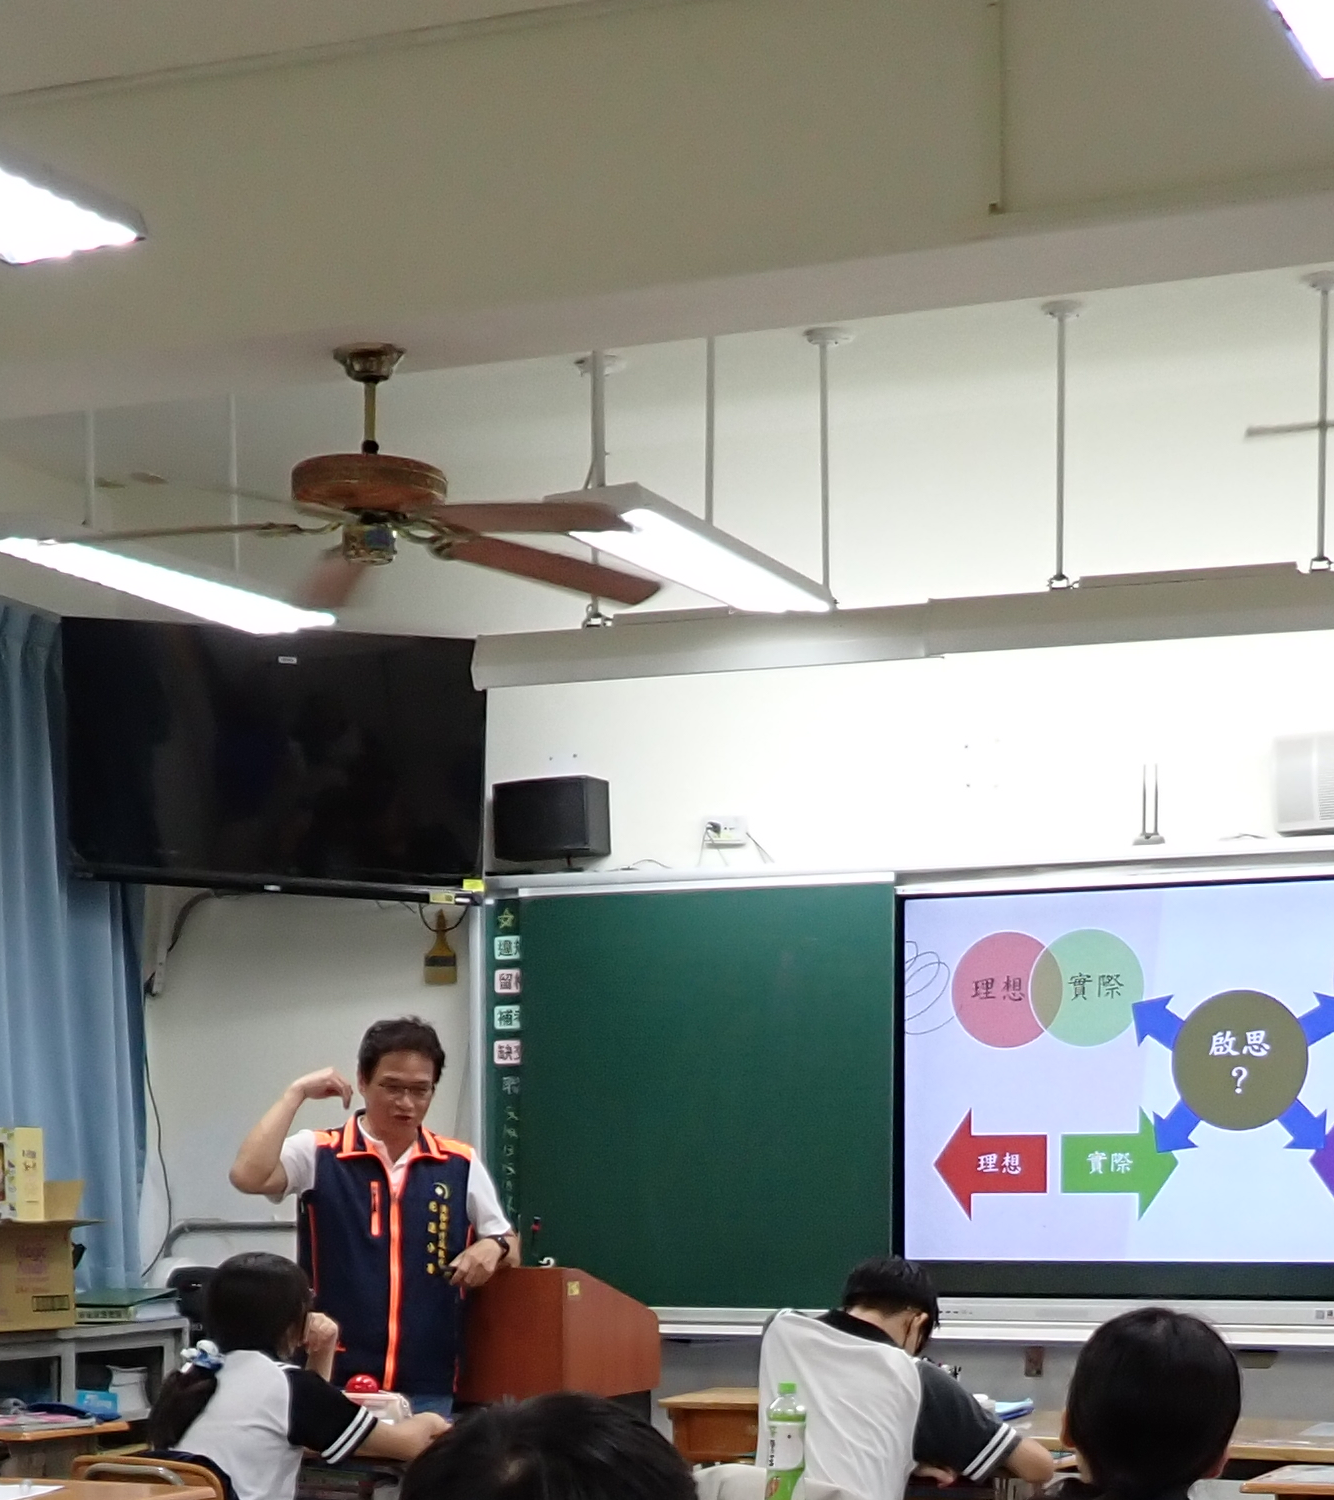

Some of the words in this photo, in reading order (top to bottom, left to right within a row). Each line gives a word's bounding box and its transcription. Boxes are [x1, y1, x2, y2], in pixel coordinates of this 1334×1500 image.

[971, 975, 1025, 1002] 理想
[1068, 972, 1124, 1001] 實際
[1208, 1030, 1271, 1057] 啟思
[1231, 1066, 1247, 1094] ?
[976, 1152, 1022, 1175] 理想
[1086, 1151, 1134, 1175] 實際
